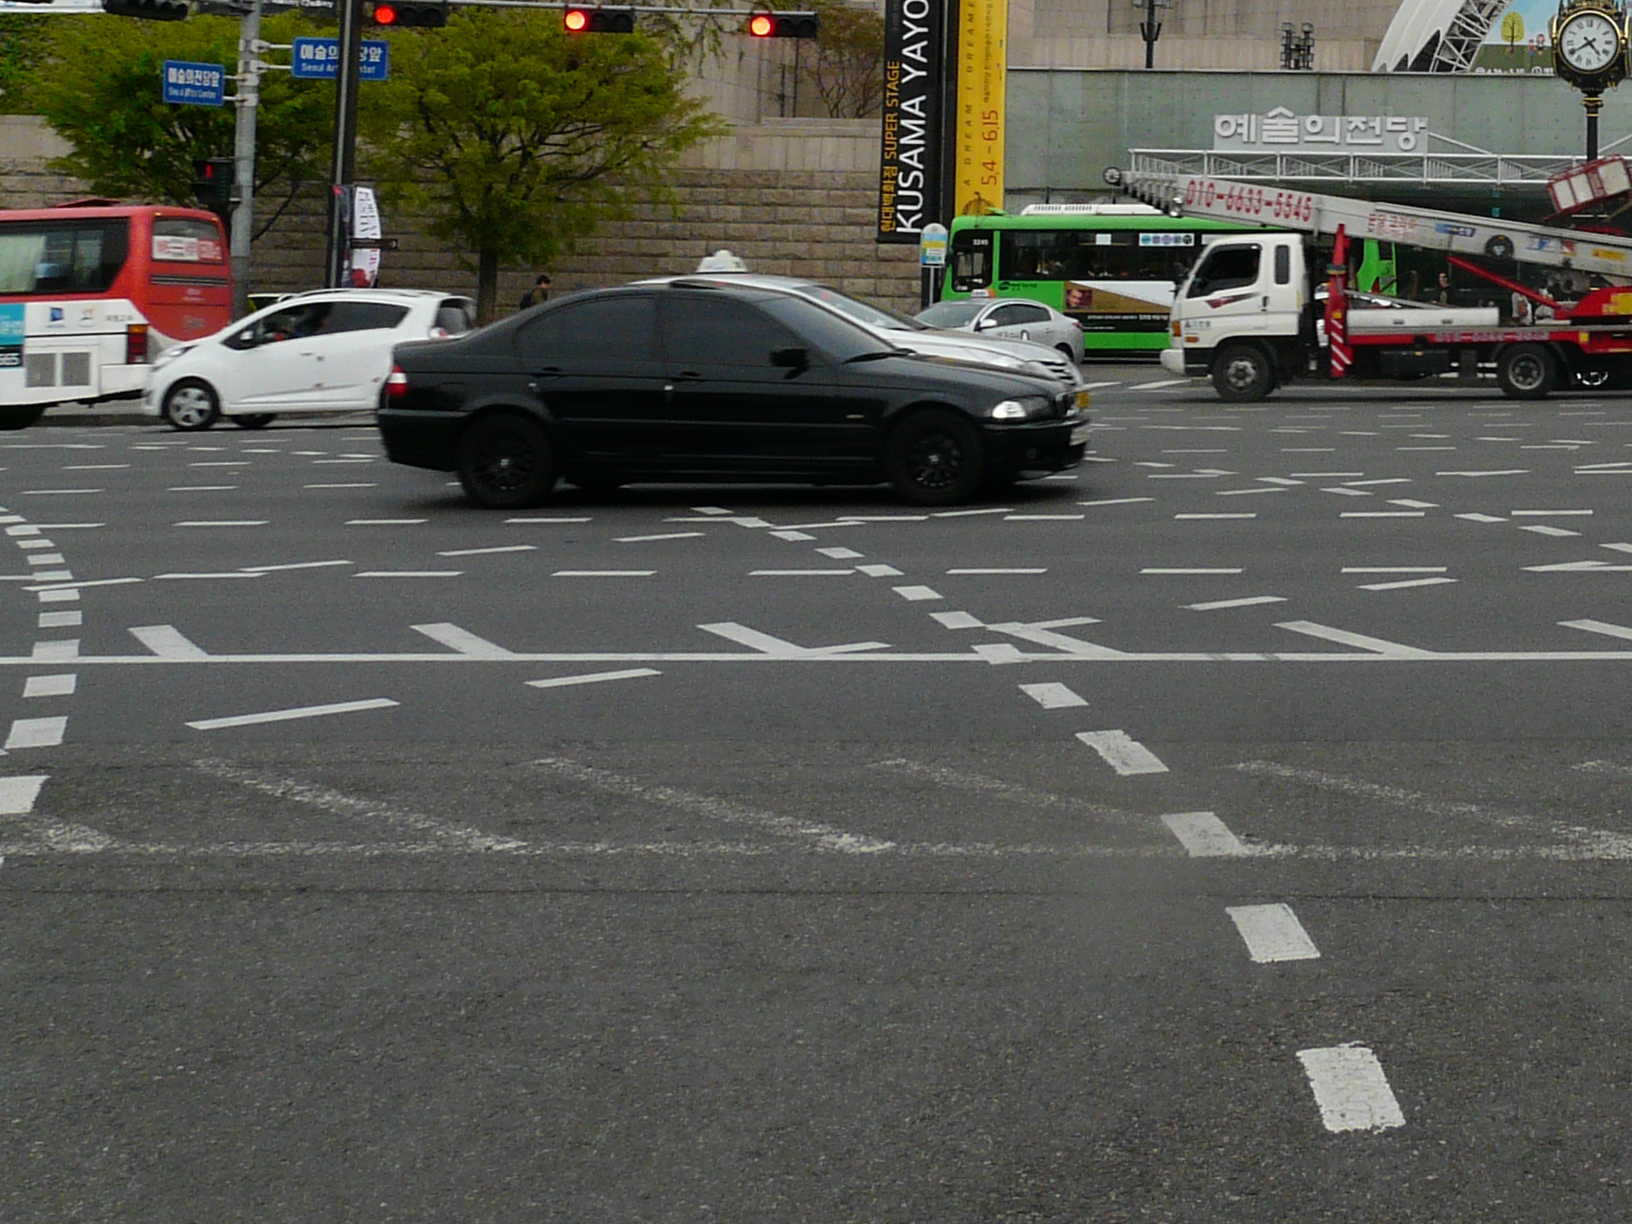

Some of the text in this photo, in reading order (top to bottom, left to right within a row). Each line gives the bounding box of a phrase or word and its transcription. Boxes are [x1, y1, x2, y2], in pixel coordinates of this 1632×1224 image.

[885, 60, 900, 108] STAGE
[884, 112, 898, 160] SUPER
[964, 104, 973, 165] DREAM
[982, 109, 999, 142] 6.15
[1214, 106, 1428, 151] 예술의전당
[896, 95, 927, 233] KUSAMA
[981, 159, 998, 186] 5.4
[1185, 179, 1311, 222] 010-6633-5545
